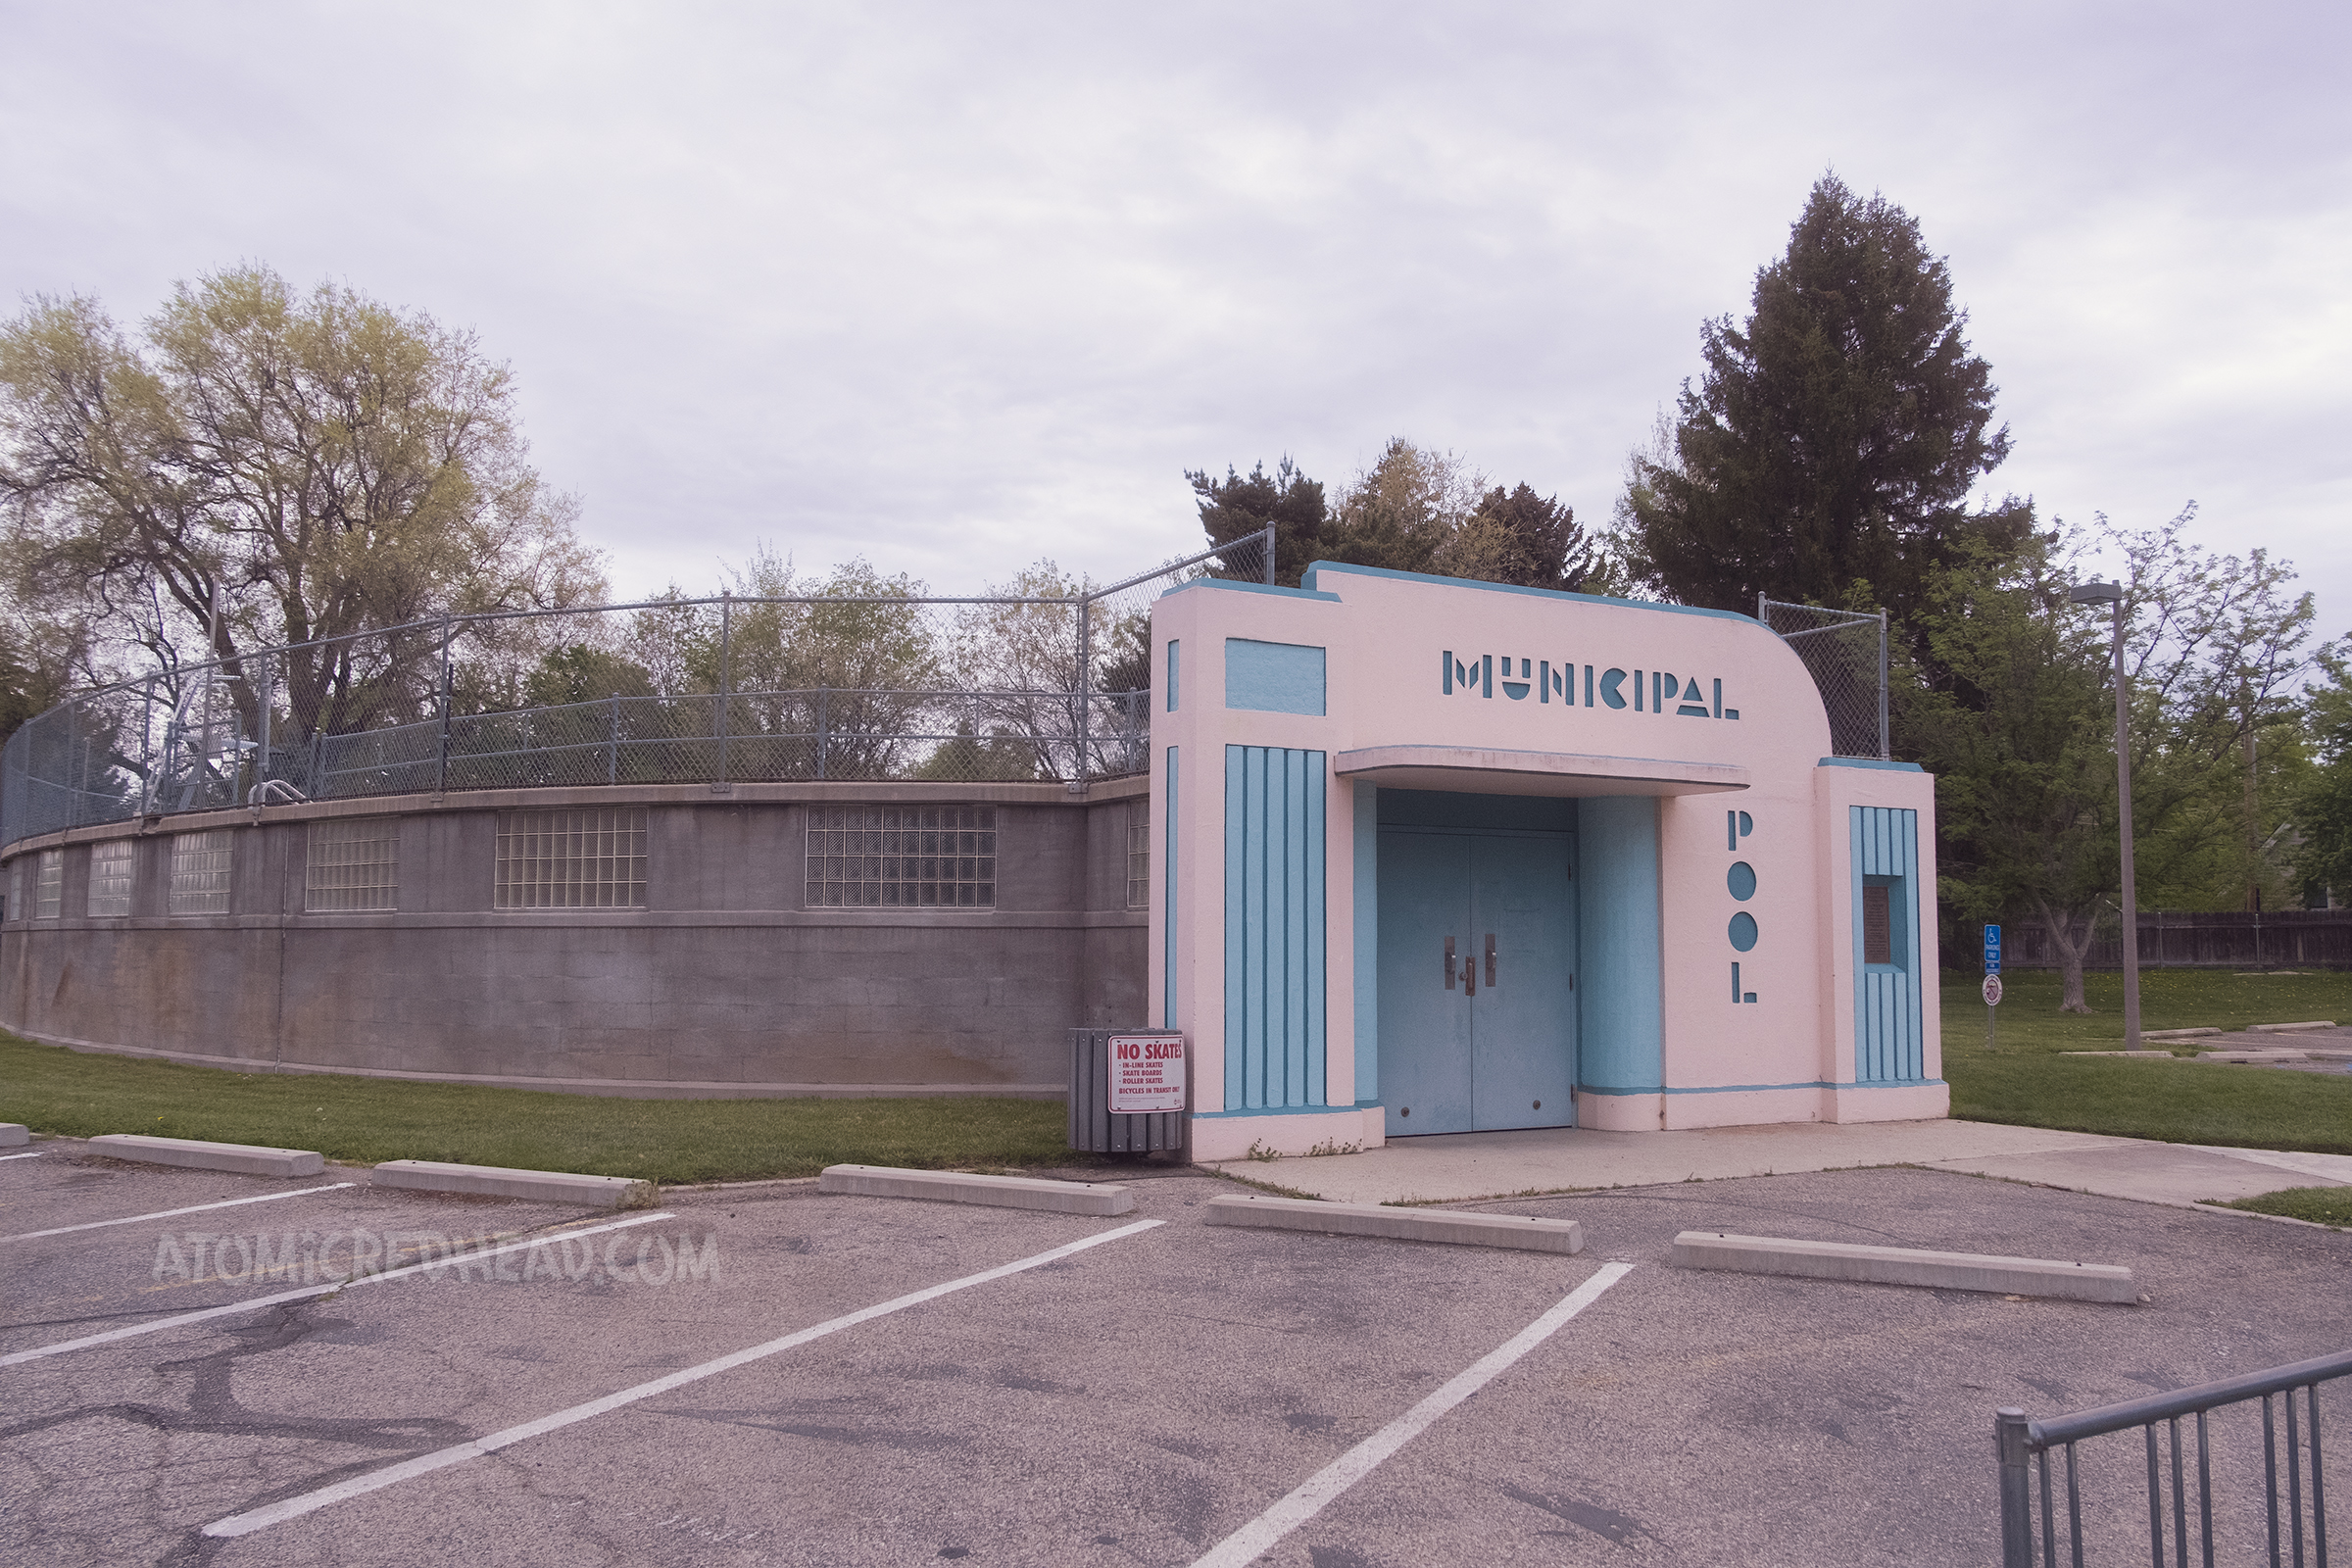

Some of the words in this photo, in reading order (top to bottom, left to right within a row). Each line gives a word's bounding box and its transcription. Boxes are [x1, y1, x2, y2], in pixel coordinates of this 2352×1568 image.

[1442, 650, 1740, 720] MUNICIPAL
[1726, 809, 1758, 1004] POOL
[1117, 1044, 1140, 1059] NO
[1145, 1043, 1182, 1059] SKATES
